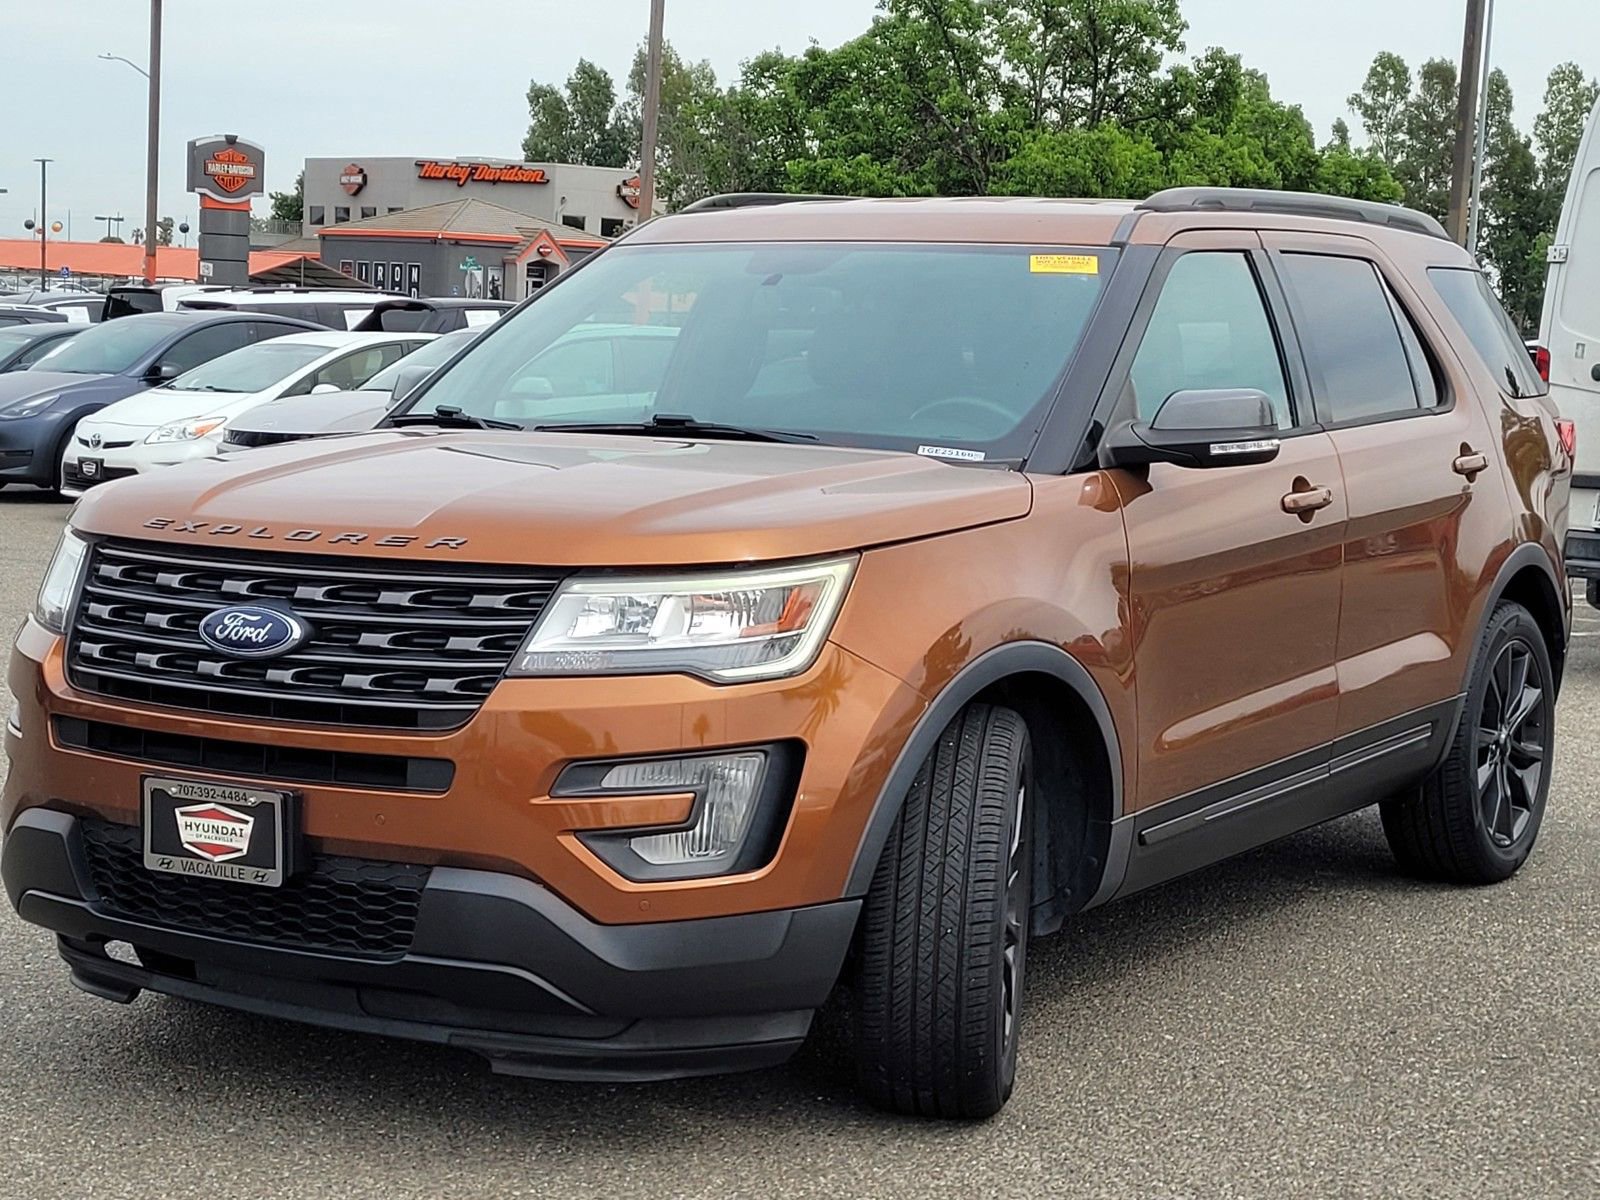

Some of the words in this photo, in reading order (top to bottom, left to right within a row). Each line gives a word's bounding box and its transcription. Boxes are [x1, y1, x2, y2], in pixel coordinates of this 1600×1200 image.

[207, 163, 254, 176] HARLEY-DAVIDSON
[416, 160, 549, 187] Harley-Davidson
[143, 517, 468, 549] EXPLORER
[214, 611, 271, 644] Ford
[177, 784, 248, 802] 707-392-4484
[184, 821, 244, 838] HYUNDAI
[203, 835, 233, 843] VACAVILLE
[180, 859, 246, 880] VACAVILLE
